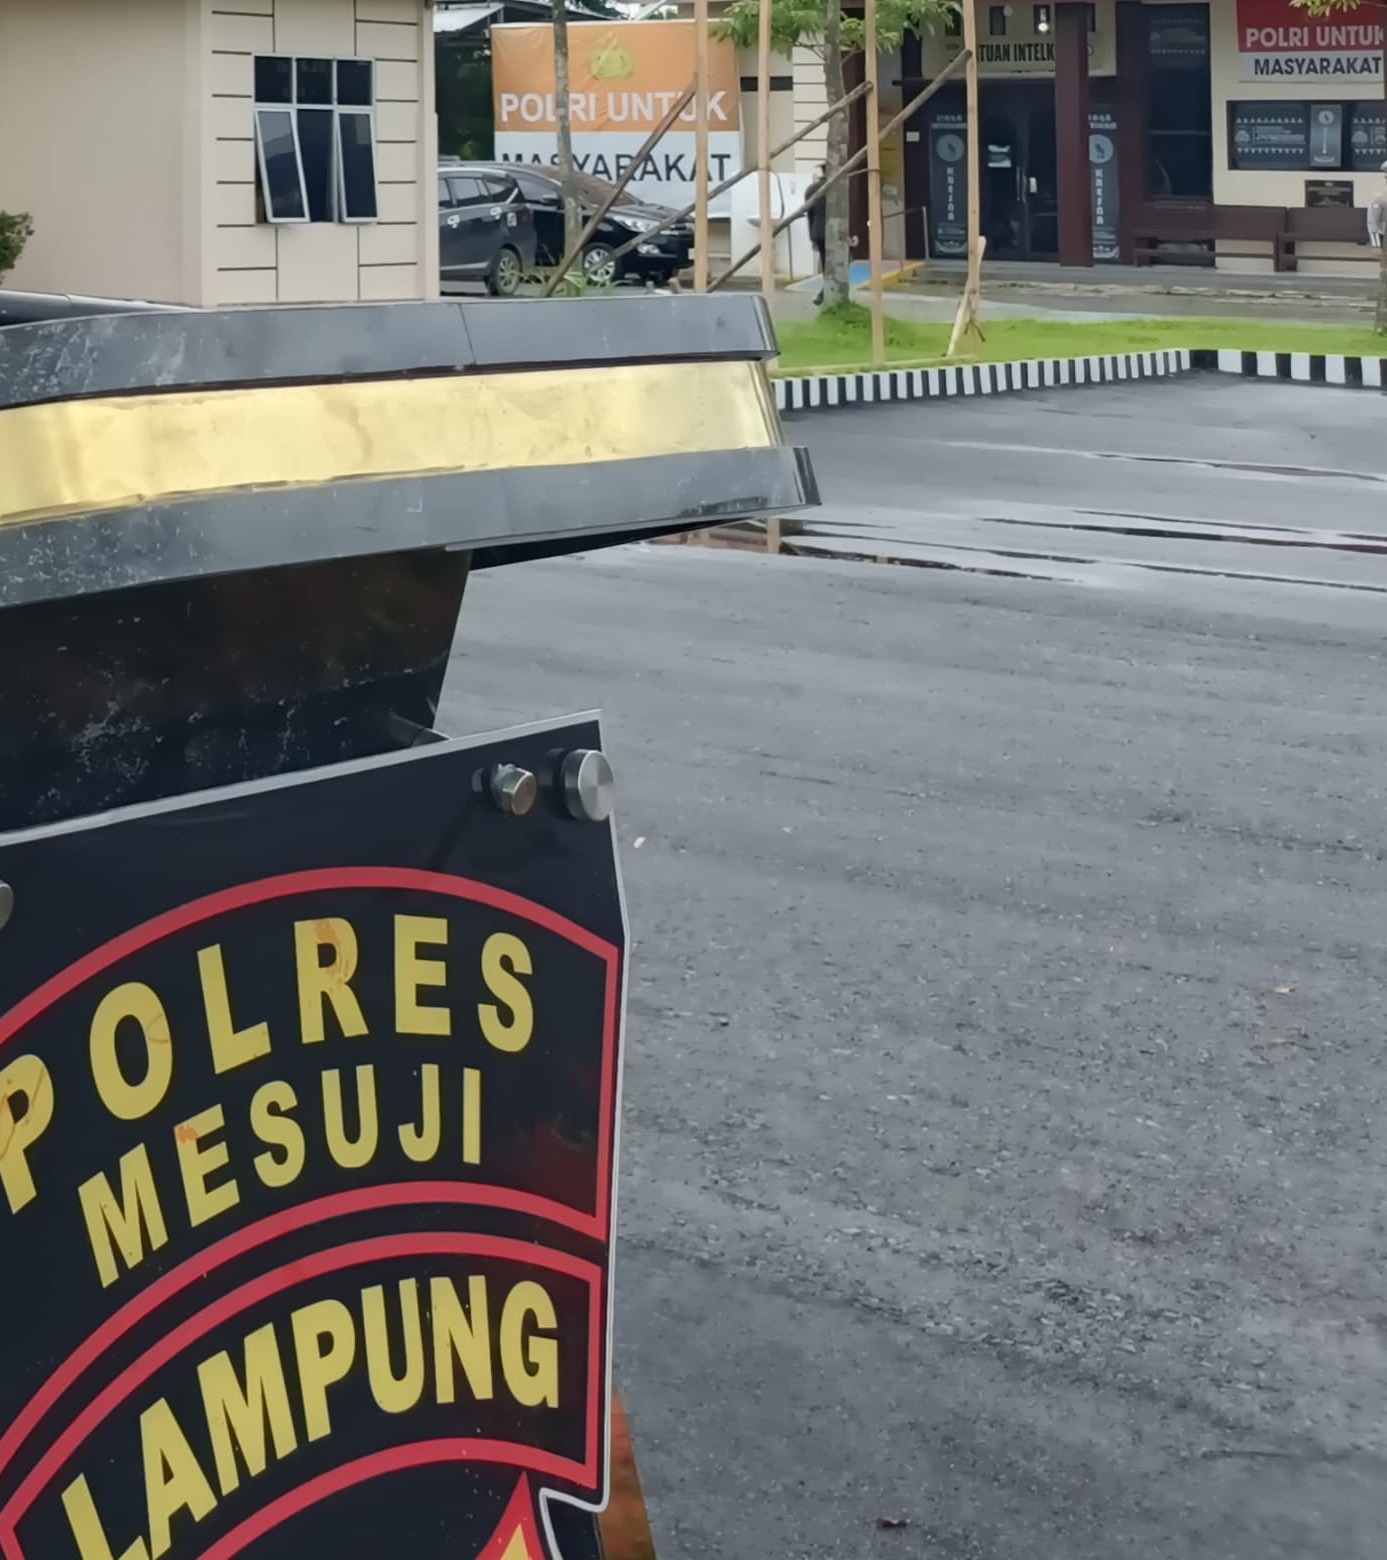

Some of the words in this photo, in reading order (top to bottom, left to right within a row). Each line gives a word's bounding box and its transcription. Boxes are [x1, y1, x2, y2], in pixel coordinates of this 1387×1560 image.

[1245, 26, 1310, 47] POLRI
[1254, 56, 1382, 76] MASYARAKAT
[501, 92, 595, 123] POLRI
[78, 1064, 481, 1289] MESUJI
[60, 1275, 559, 1560] LAMPUNG
